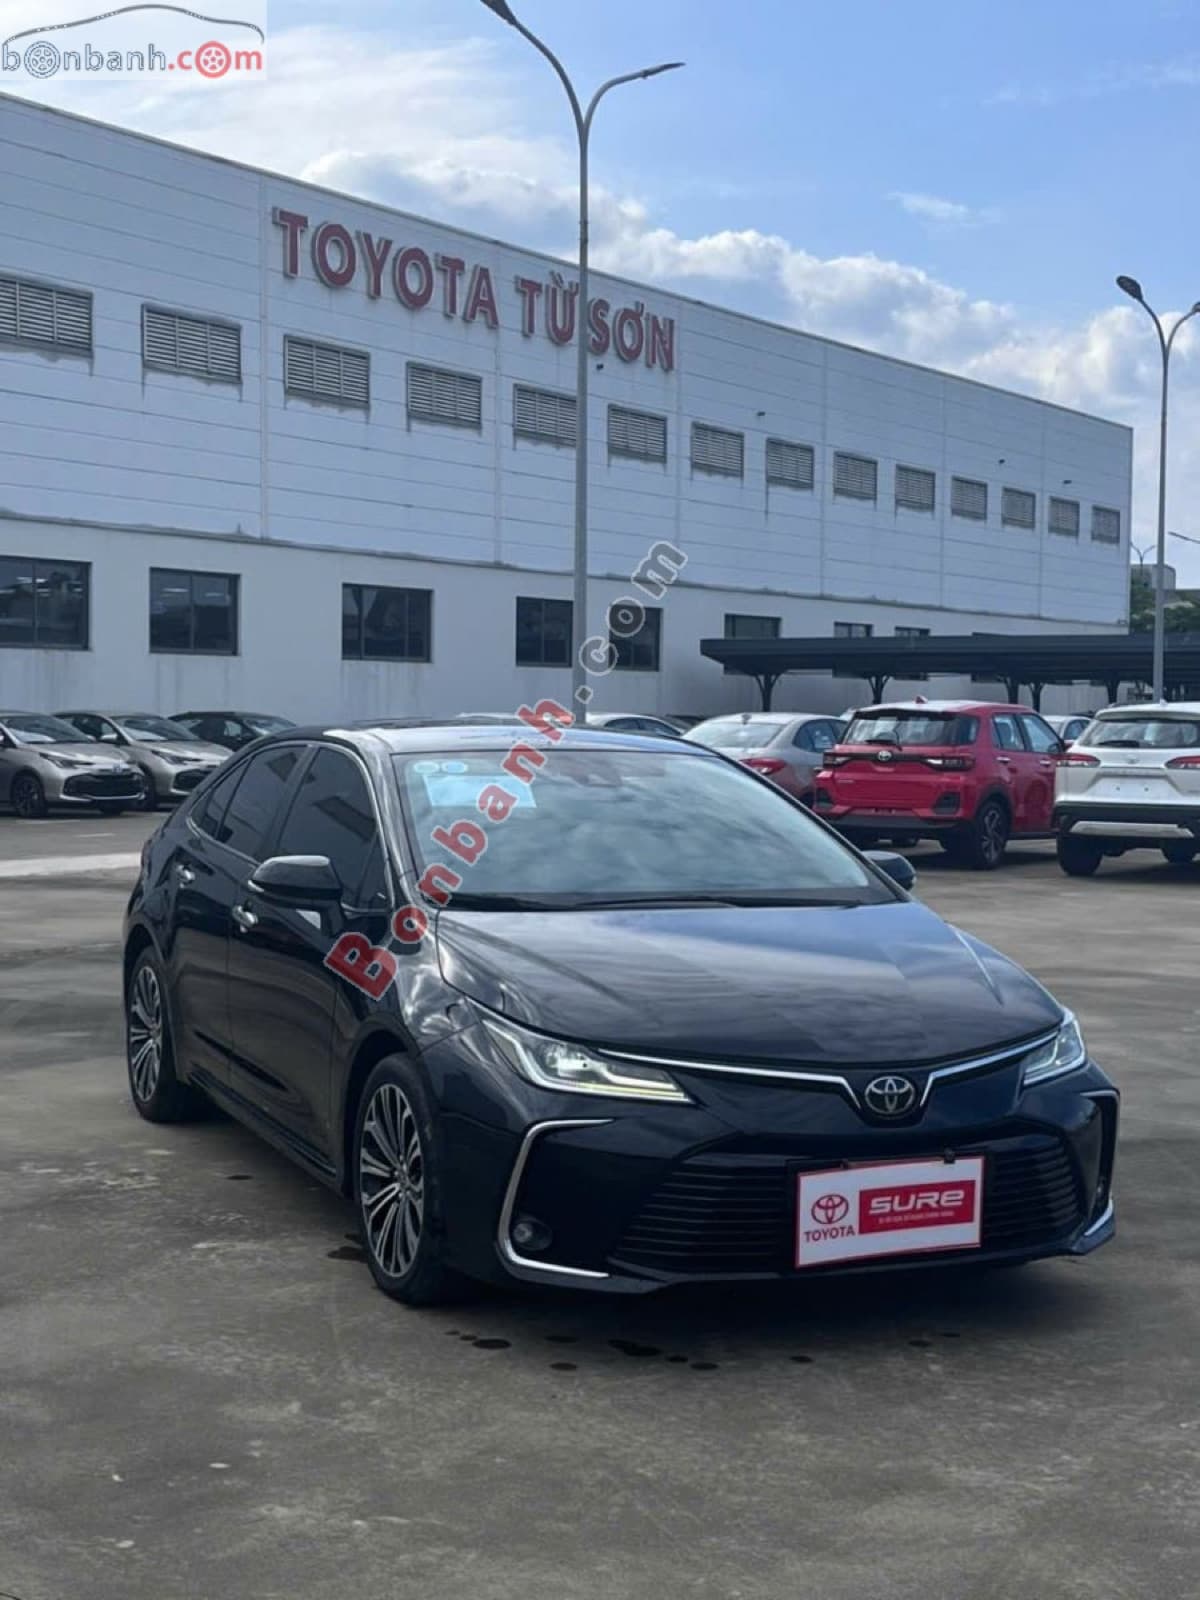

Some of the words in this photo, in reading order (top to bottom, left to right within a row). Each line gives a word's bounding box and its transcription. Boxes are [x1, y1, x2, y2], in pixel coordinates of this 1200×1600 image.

[272, 206, 499, 330] TOYOTA
[514, 270, 580, 346] TỪ
[588, 296, 675, 371] SƠN
[804, 1225, 856, 1243] TOYOTA
